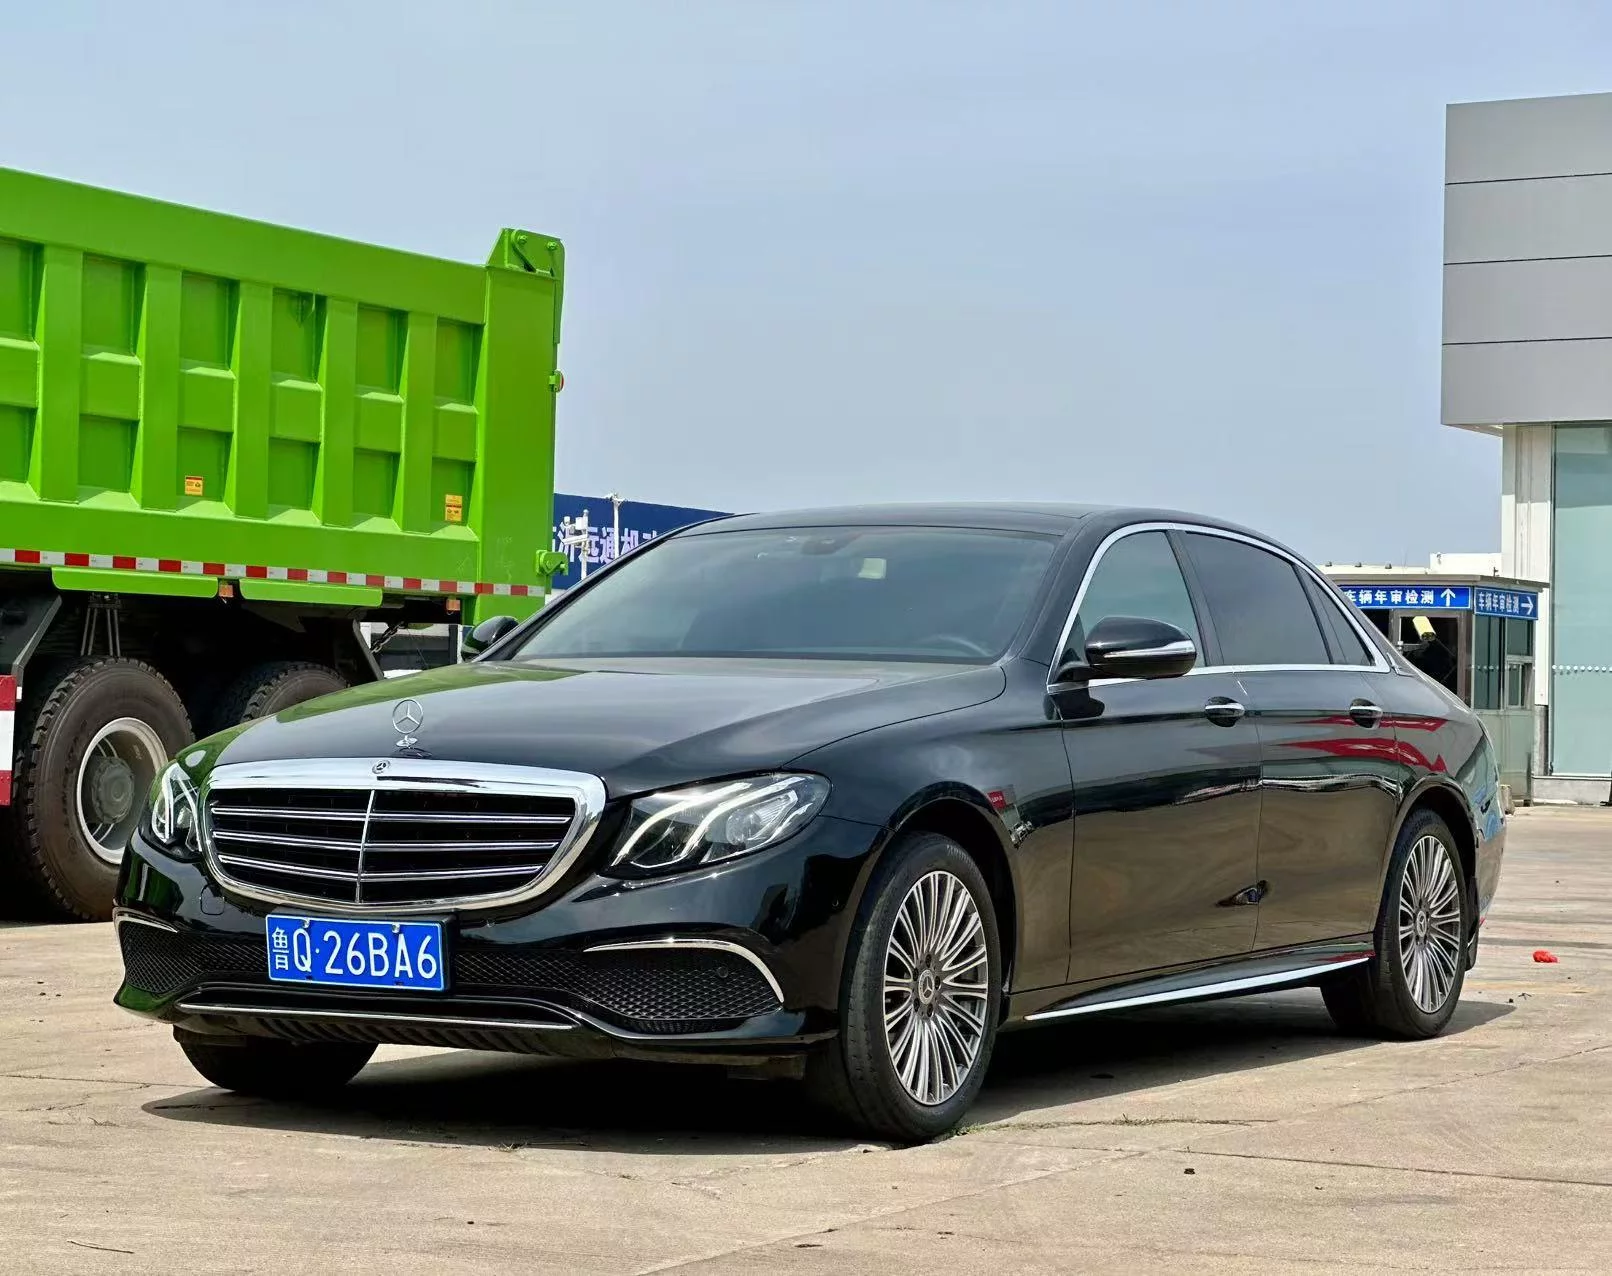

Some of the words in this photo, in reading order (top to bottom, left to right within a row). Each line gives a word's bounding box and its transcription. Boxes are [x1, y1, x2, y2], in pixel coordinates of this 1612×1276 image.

[1343, 589, 1434, 605] 车辆年审检测
[1478, 591, 1520, 614] 车辆年审检测
